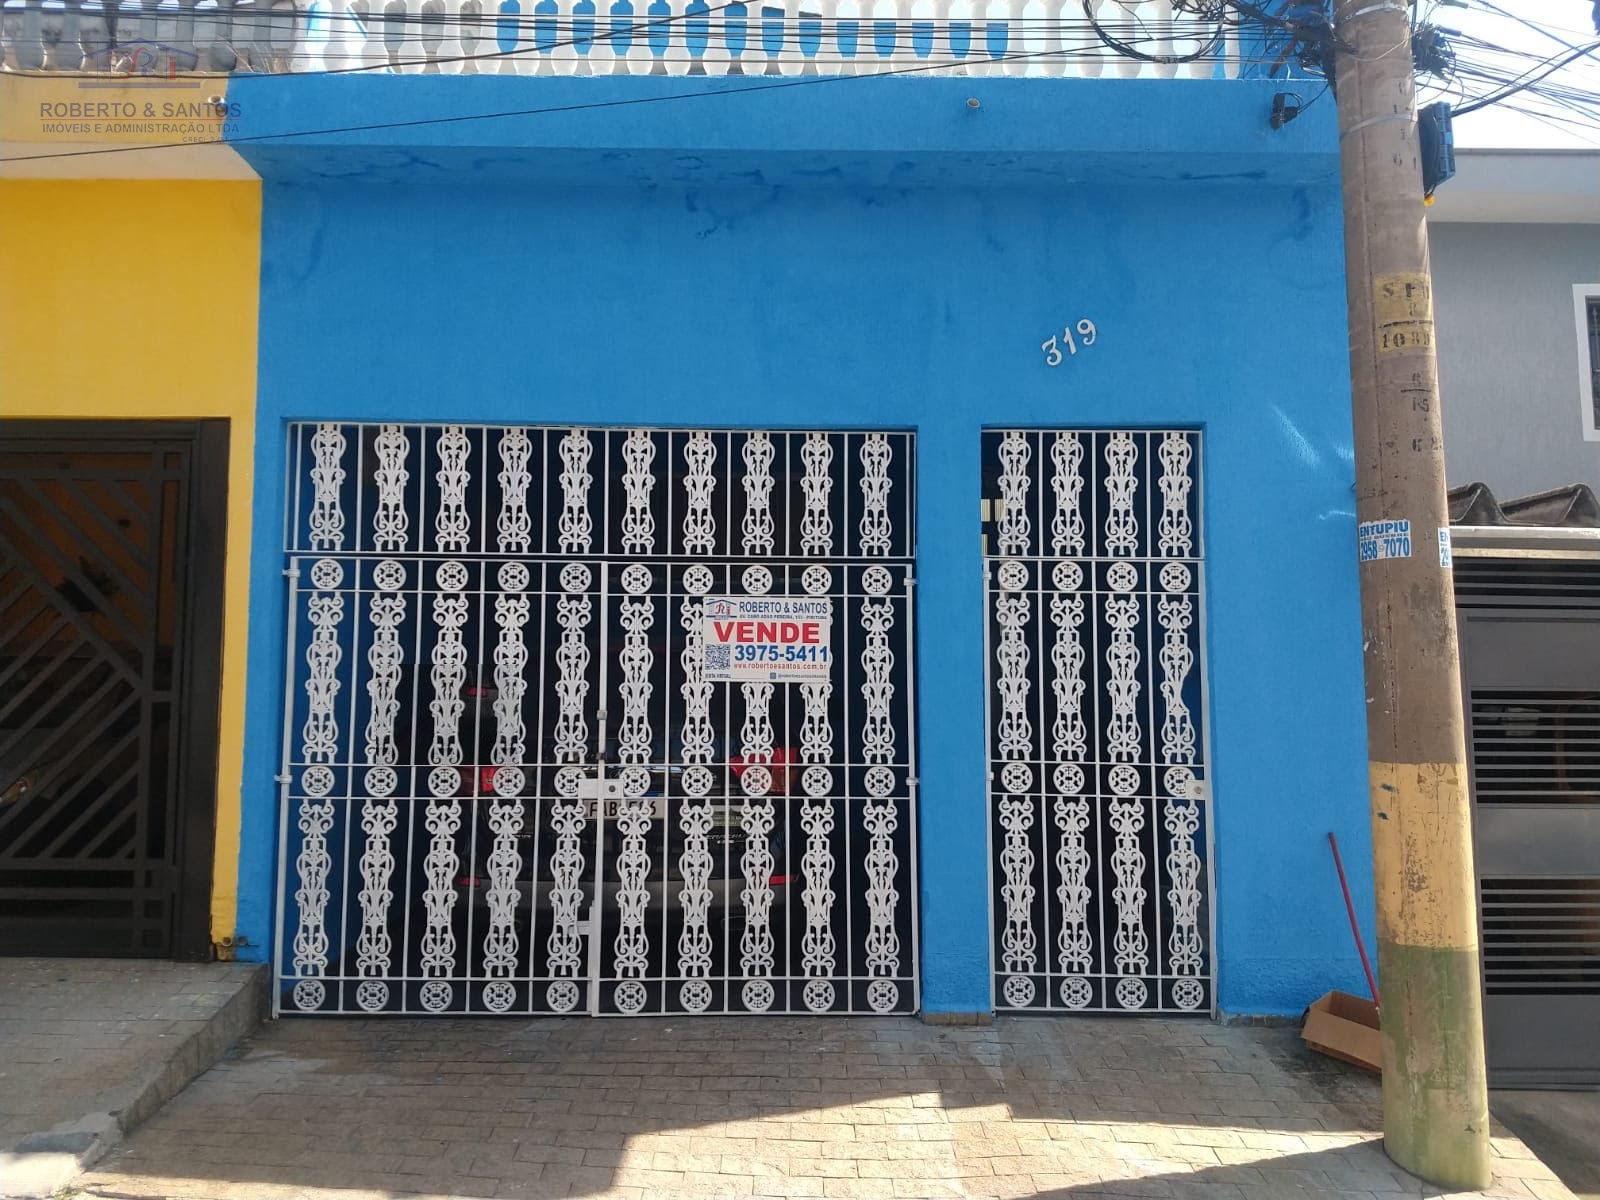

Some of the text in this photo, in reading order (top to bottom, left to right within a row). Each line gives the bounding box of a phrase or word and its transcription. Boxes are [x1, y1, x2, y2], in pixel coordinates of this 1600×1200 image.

[1041, 318, 1097, 366] 319
[1360, 520, 1409, 537] ENTUPIU
[1384, 537, 1410, 557] 7070
[739, 601, 828, 614] ROBERTO & SANTOS
[713, 621, 820, 644] VENDE
[734, 645, 828, 662] 3975-5411
